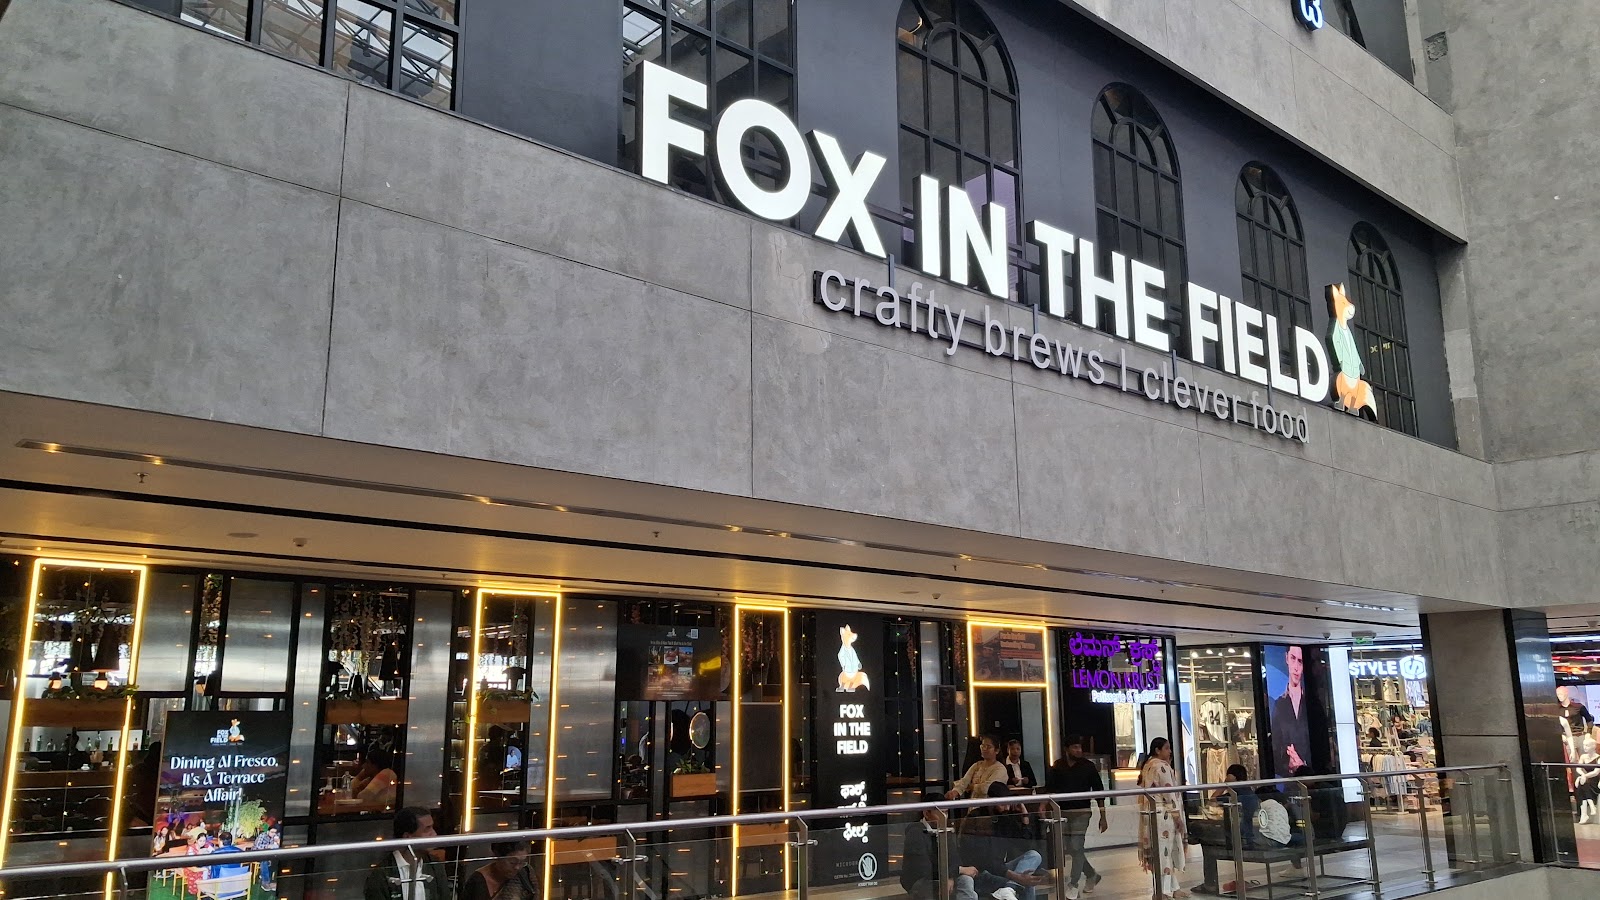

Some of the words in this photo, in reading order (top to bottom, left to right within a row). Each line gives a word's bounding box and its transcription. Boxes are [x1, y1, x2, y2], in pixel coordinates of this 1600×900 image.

[638, 60, 887, 258] FOX
[917, 173, 1009, 299] IN
[1030, 220, 1170, 353] THE
[1186, 281, 1330, 402] FIELD
[819, 269, 966, 355] crafty
[984, 305, 1105, 385] brews
[1143, 361, 1242, 424] clever
[1250, 390, 1310, 444] food
[1349, 661, 1398, 676] STYLE
[1073, 669, 1122, 689] LEMON
[1124, 671, 1161, 690] KRUST
[840, 704, 864, 718] FOX
[834, 722, 847, 736] IN
[849, 722, 871, 736] THE
[837, 740, 868, 754] FIELD
[170, 756, 215, 772] Dining
[218, 755, 231, 768] Al
[182, 773, 200, 786] It's
[203, 773, 212, 785] A
[217, 772, 265, 785] Terrace
[204, 787, 243, 802] Affair!
